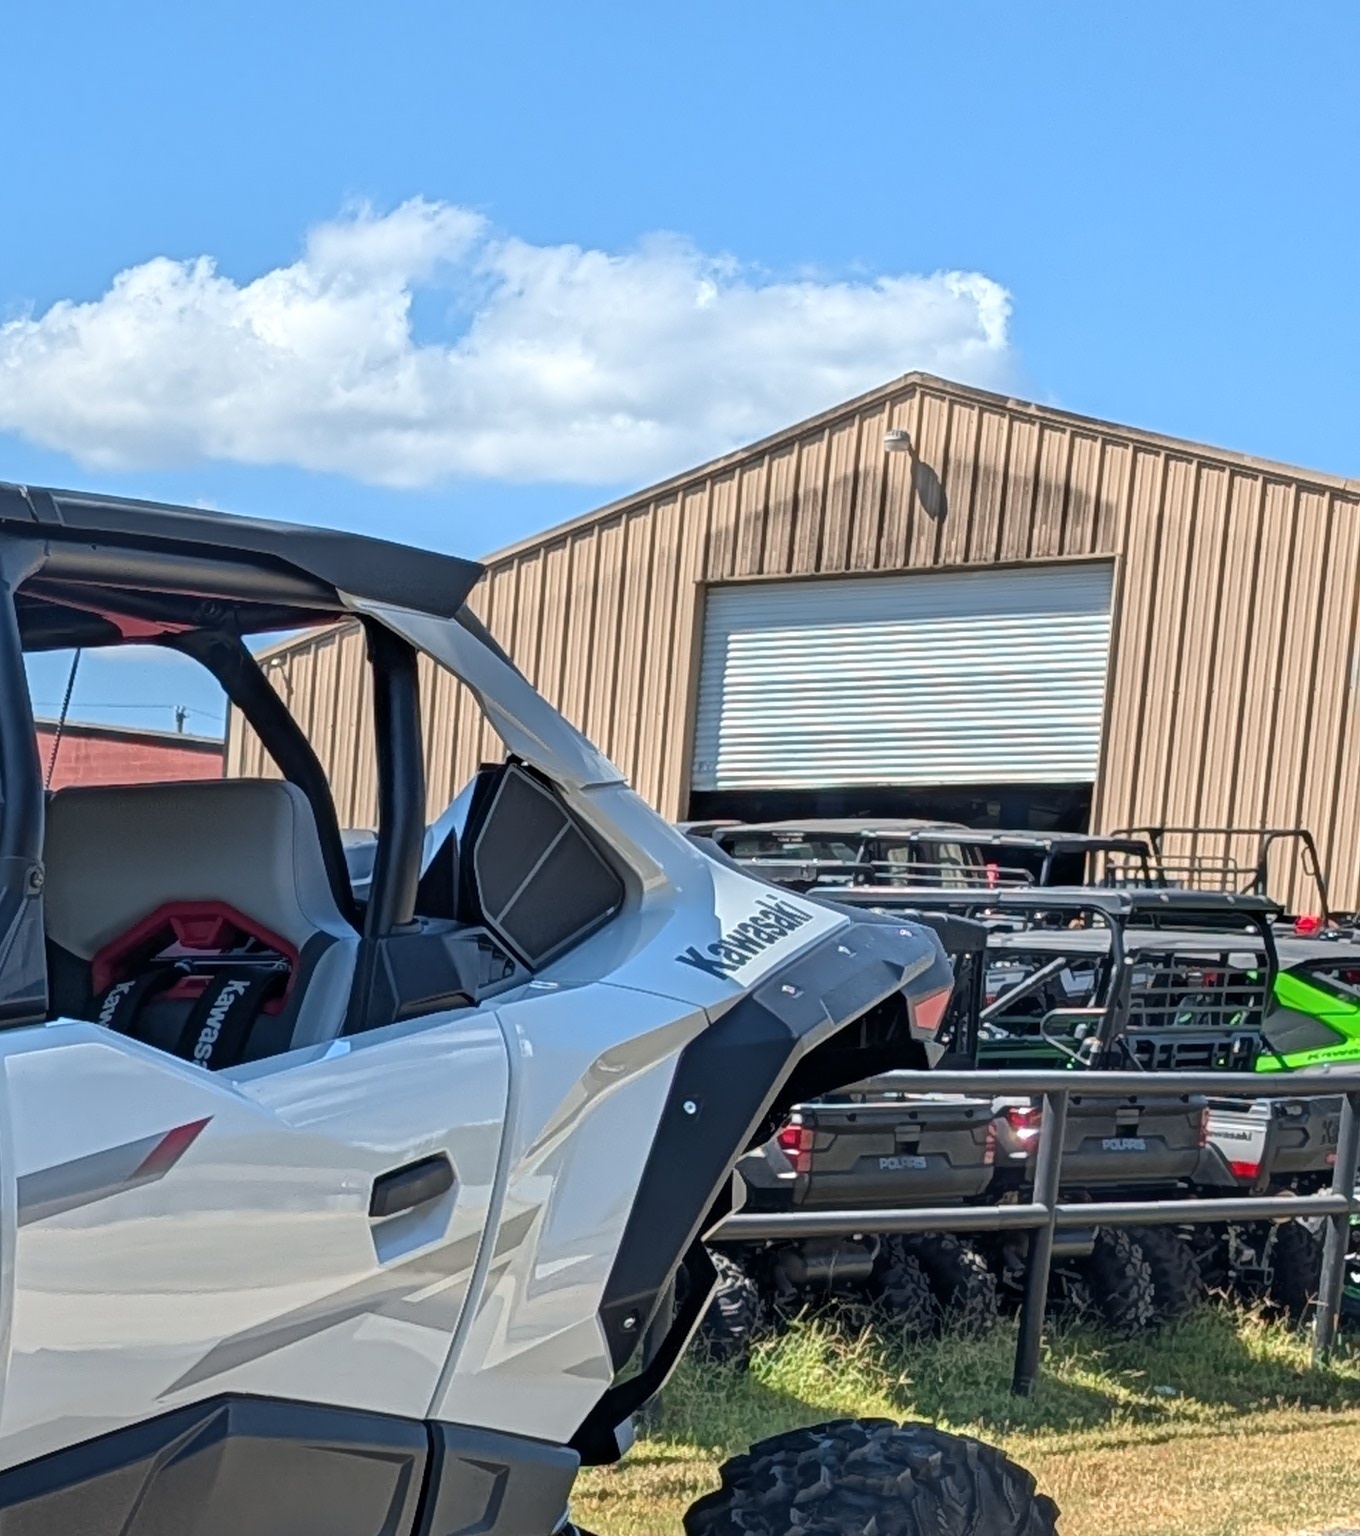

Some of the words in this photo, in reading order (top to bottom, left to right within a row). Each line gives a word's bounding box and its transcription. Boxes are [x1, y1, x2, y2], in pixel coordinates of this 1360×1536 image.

[674, 893, 814, 981] Kawasaki
[1102, 1137, 1147, 1151] POLARIS
[878, 1155, 928, 1170] POLARIS
